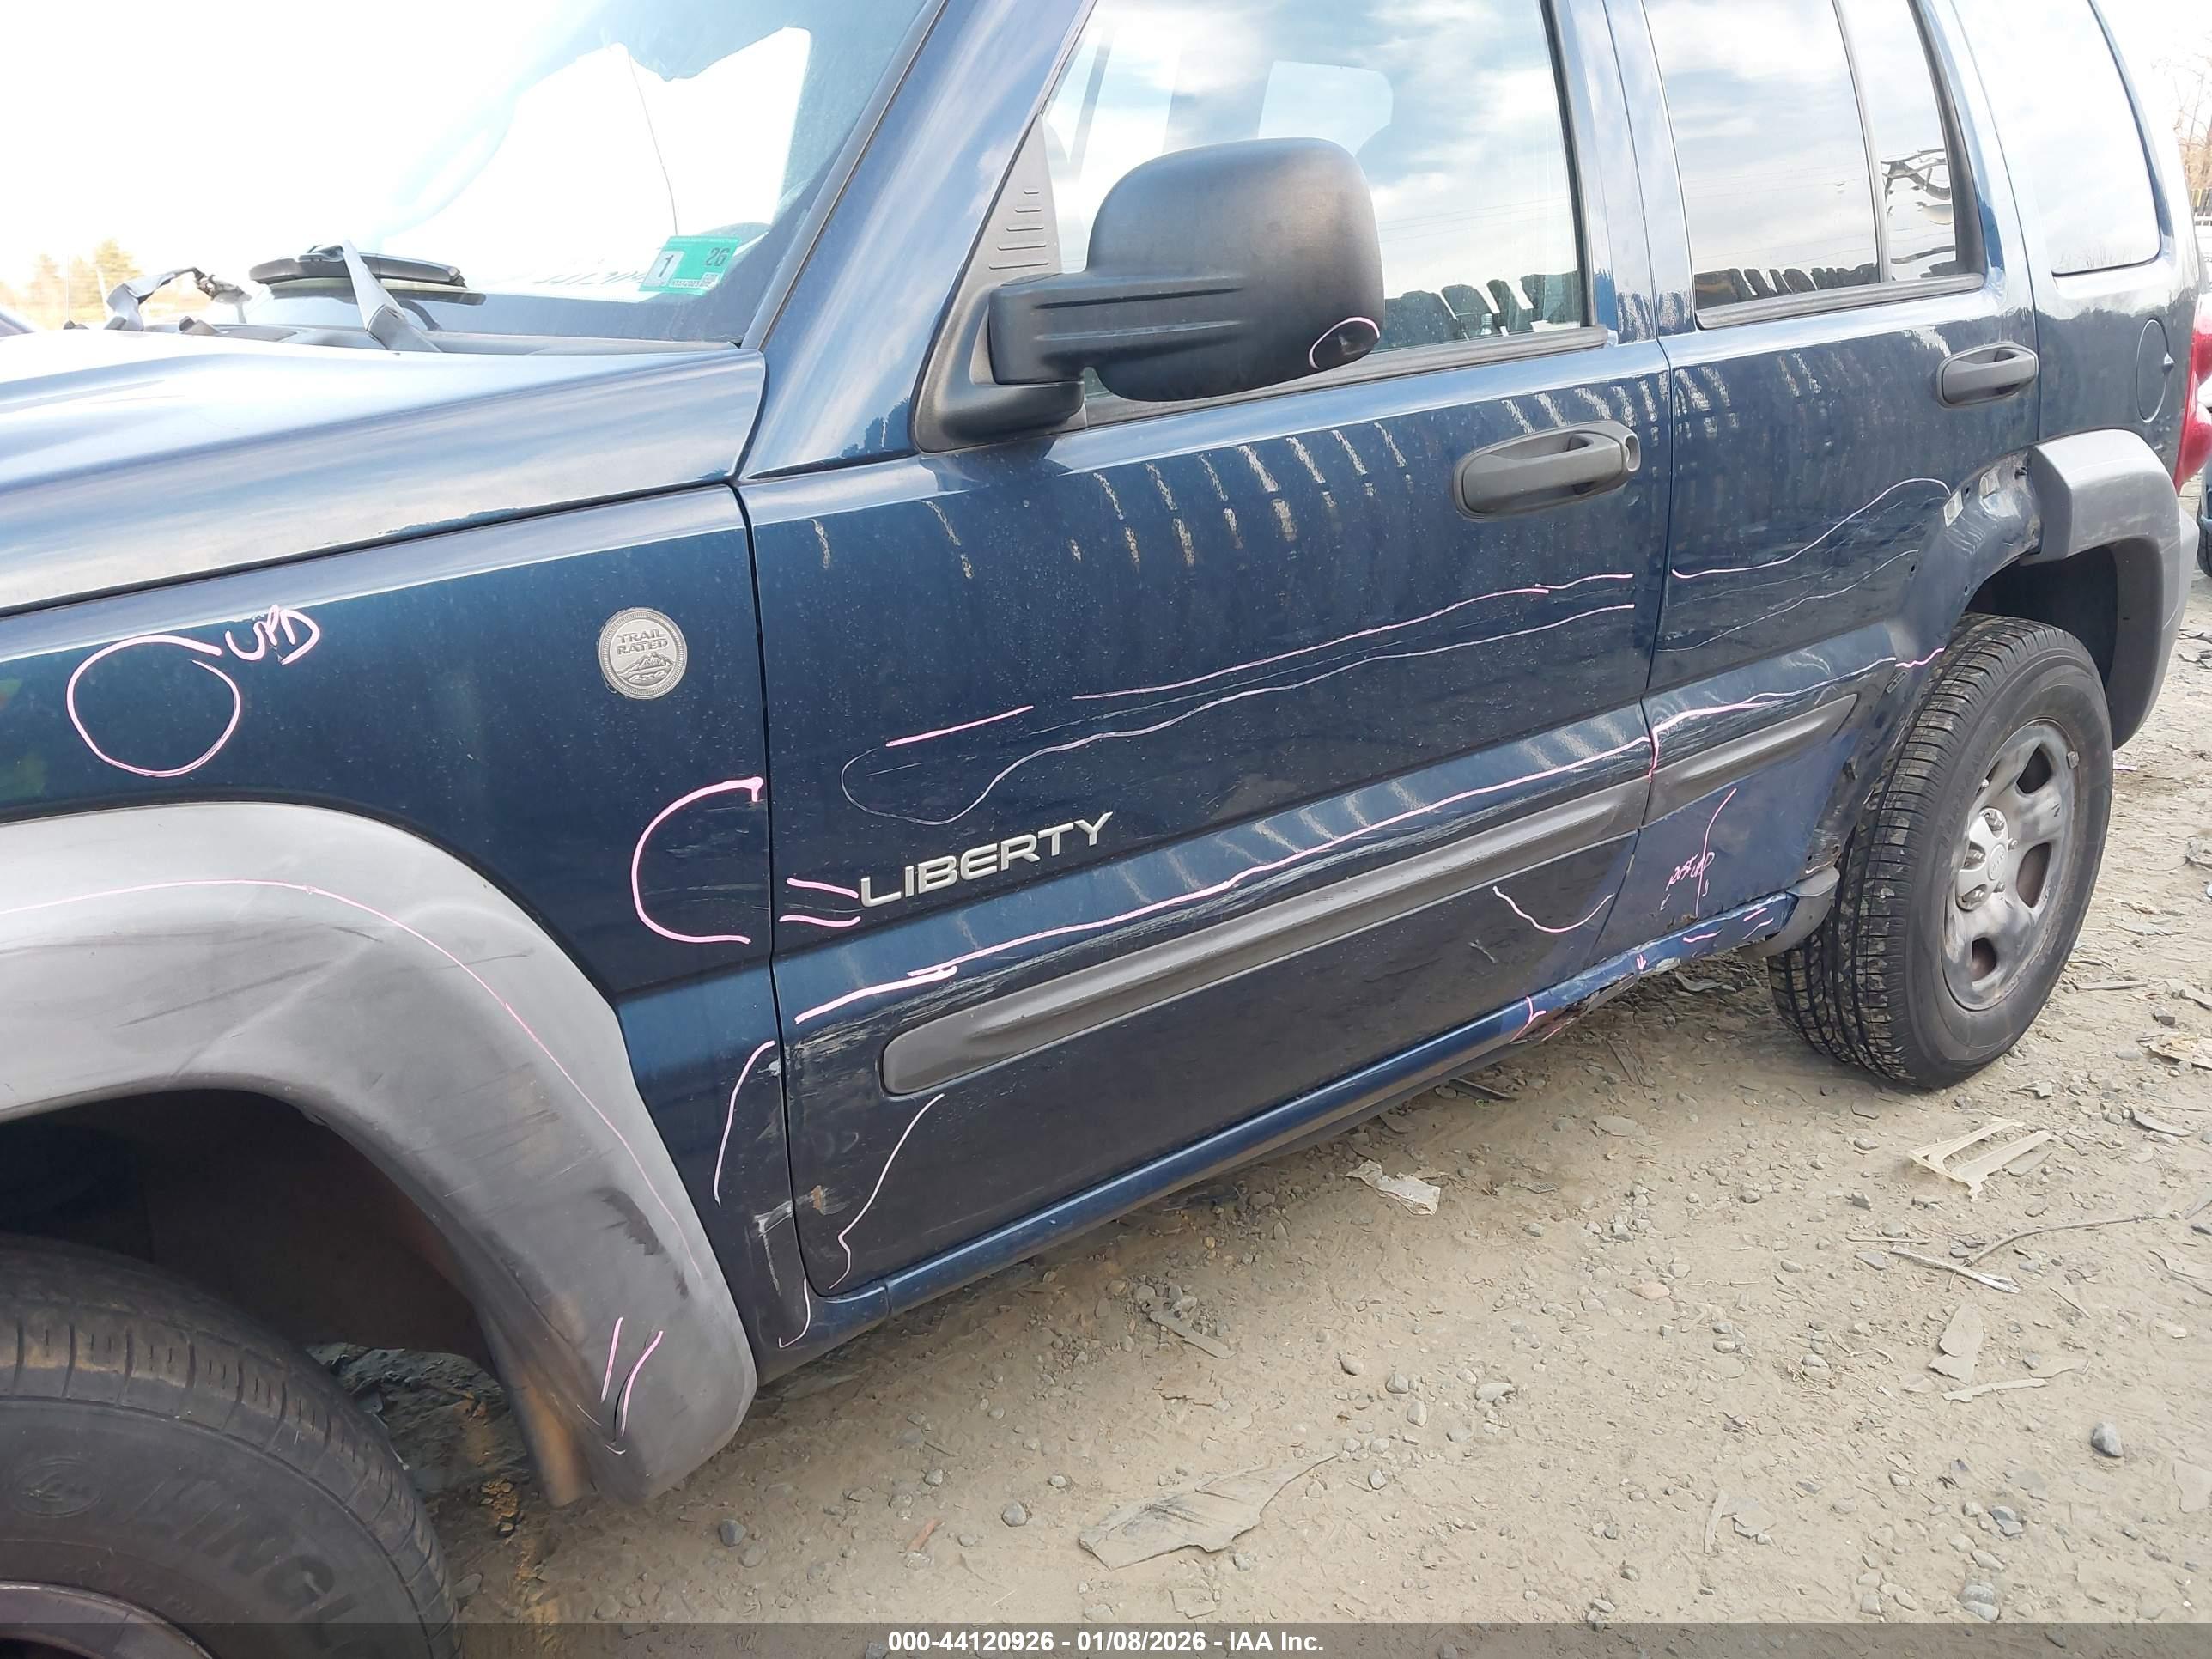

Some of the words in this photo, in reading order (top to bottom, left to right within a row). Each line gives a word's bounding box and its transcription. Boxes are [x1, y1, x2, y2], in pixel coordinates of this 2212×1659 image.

[658, 253, 674, 278] 1
[705, 246, 731, 267] 26
[617, 629, 665, 643] TRAIL
[617, 638, 668, 655] RATED
[860, 811, 1114, 908] LIBERTY
